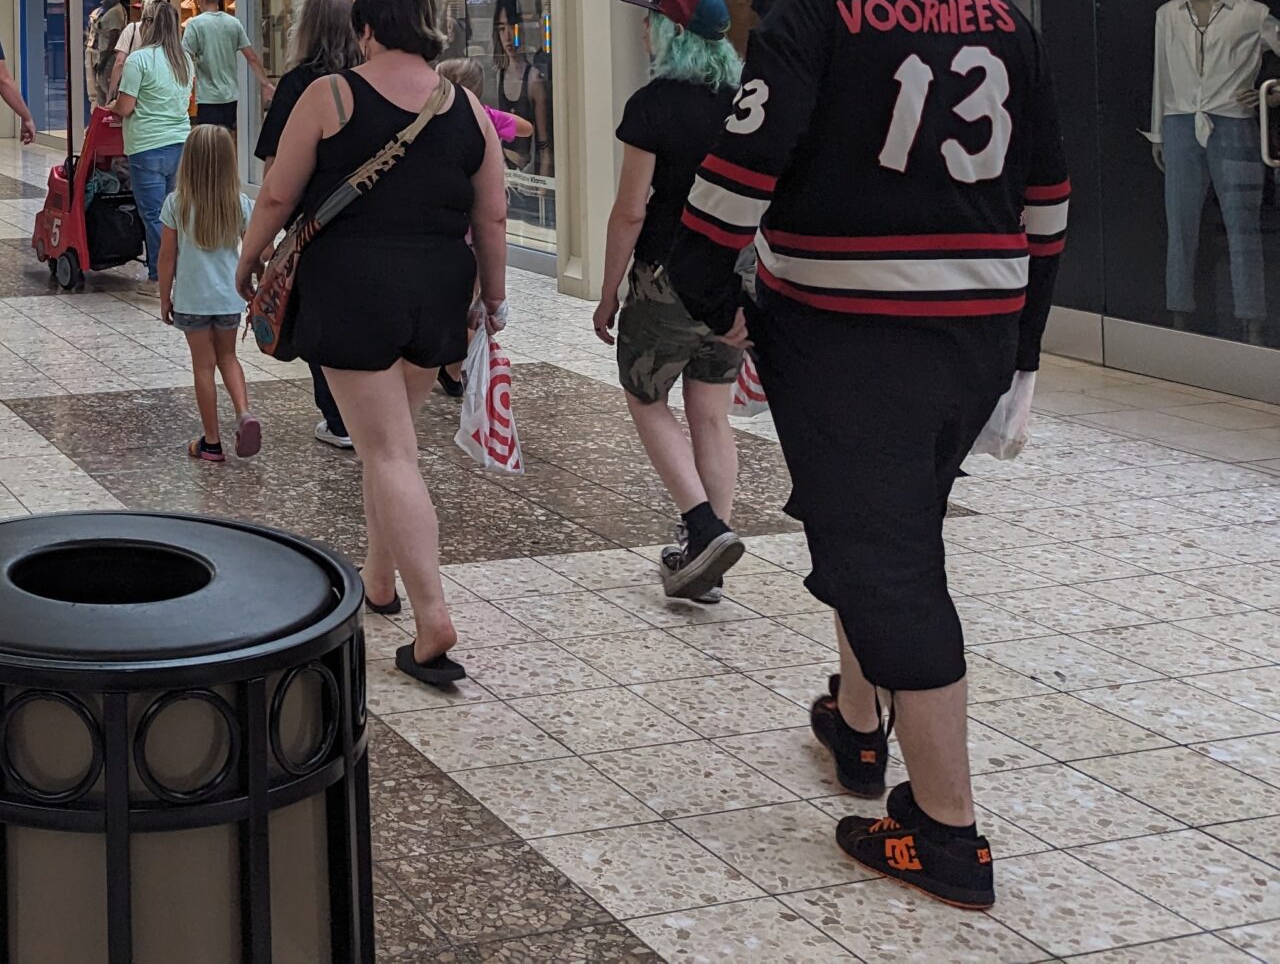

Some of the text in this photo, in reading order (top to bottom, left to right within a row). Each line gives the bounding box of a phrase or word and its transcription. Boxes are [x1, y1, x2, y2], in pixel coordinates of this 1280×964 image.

[724, 78, 769, 134] 3
[878, 45, 1013, 184] 13
[51, 218, 62, 247] 5
